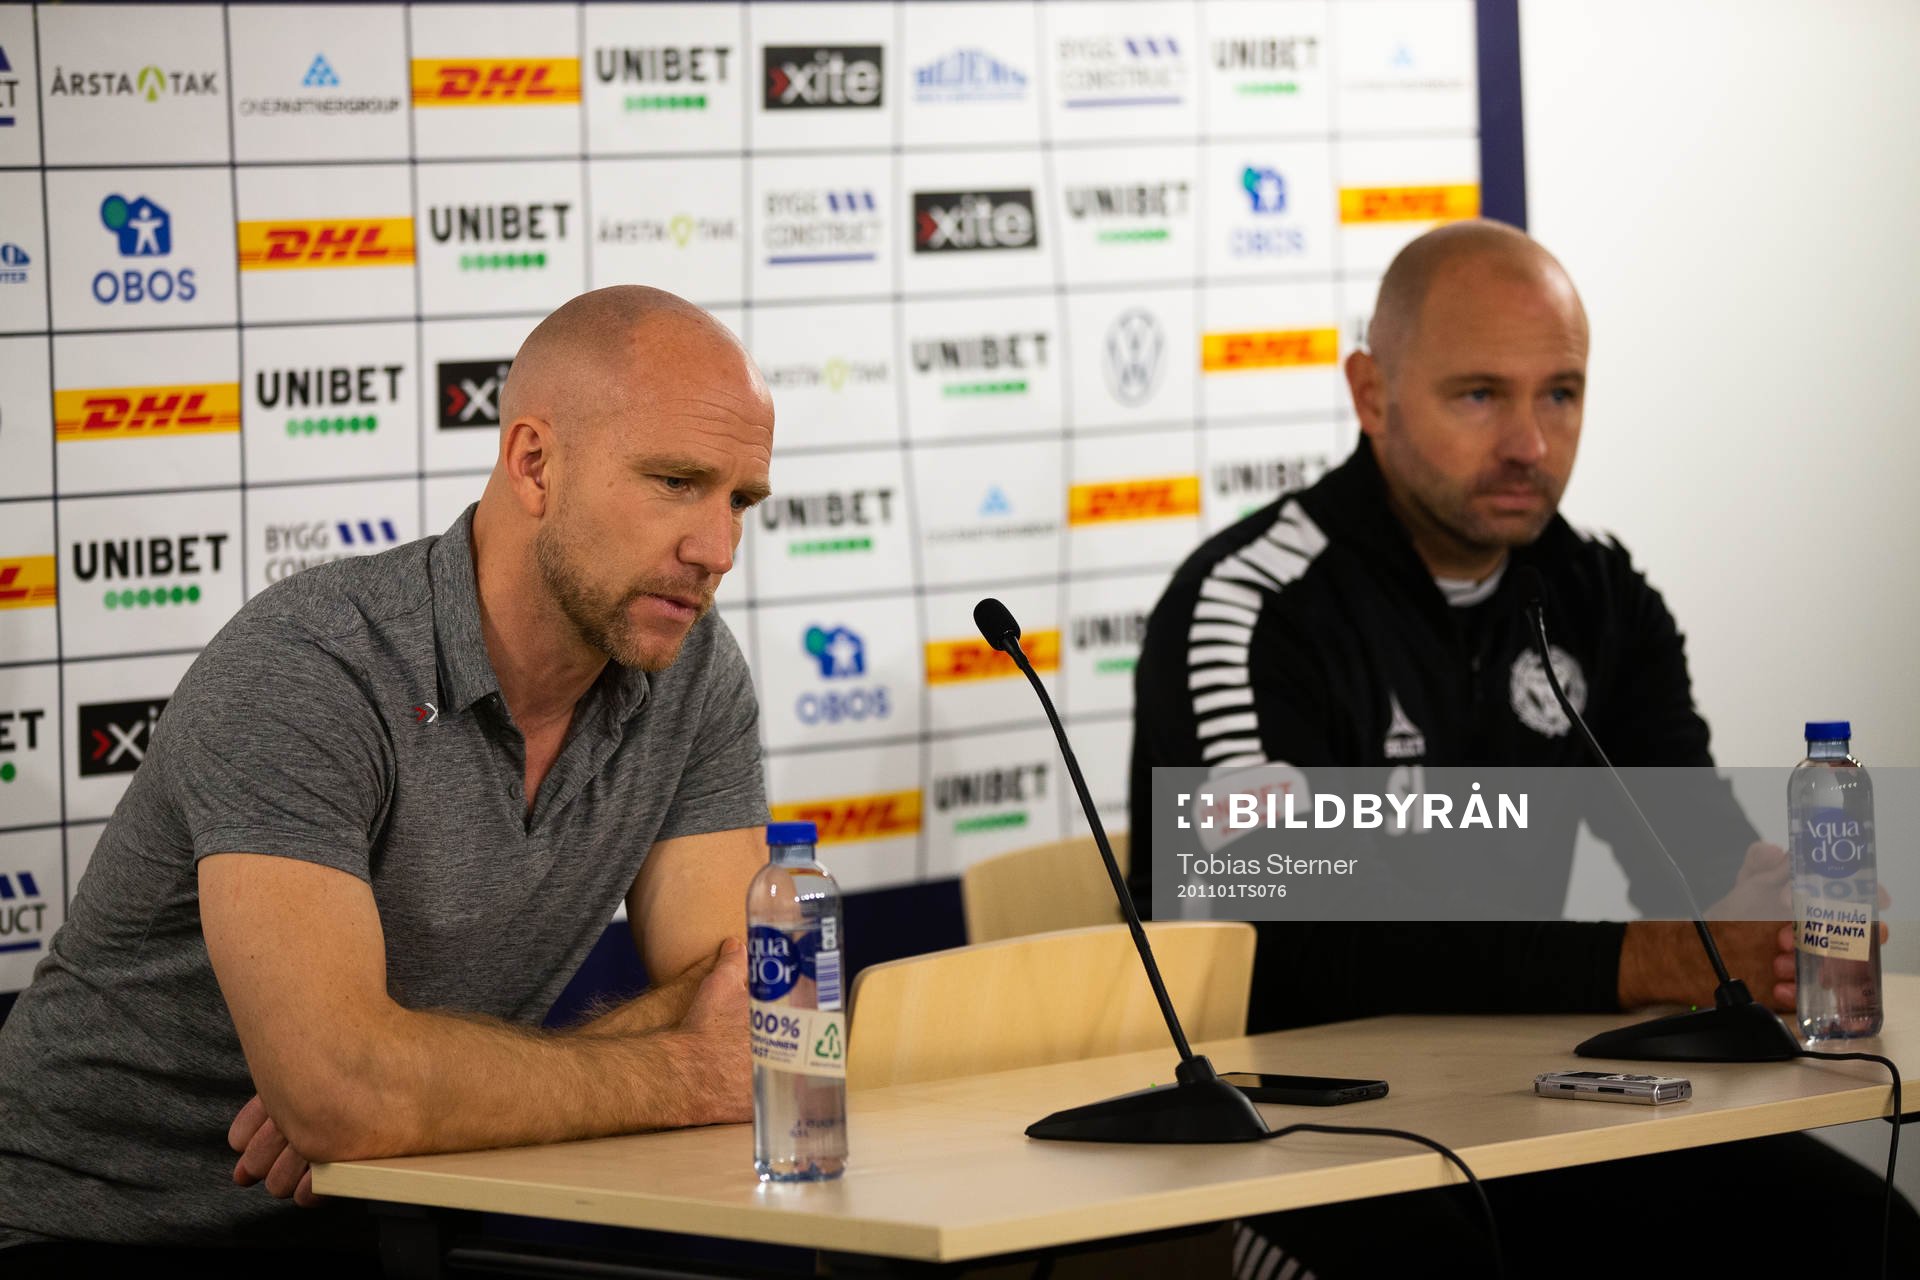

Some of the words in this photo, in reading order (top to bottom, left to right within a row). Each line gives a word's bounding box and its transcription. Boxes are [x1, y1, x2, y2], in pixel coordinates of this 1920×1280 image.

[595, 48, 730, 82] UNIBET
[1212, 37, 1319, 70] UNIBET
[51, 67, 133, 96] ÅRSTA
[172, 72, 218, 95] TAK
[437, 66, 556, 98] DHL
[783, 50, 881, 105] xite
[1065, 180, 1189, 220] UNIBET
[430, 203, 571, 243] UNIBET
[929, 194, 1034, 249] xite
[265, 226, 390, 262] DHL
[92, 268, 197, 304] OBOS
[911, 332, 1050, 372] UNIBET
[256, 366, 403, 408] UNIBET
[82, 393, 214, 431] DHL
[760, 489, 894, 530] UNIBET
[265, 521, 329, 552] BYGG
[72, 533, 228, 582] UNIBET
[796, 686, 891, 726] OBOS
[935, 766, 1049, 809] UNIBET
[1807, 820, 1860, 845] Aqua
[1805, 920, 1823, 932] ATT
[1826, 923, 1865, 938] PANTA
[1806, 906, 1834, 920] KOM
[1838, 909, 1867, 924] IHÅG
[1804, 933, 1829, 948] MIG
[752, 1010, 800, 1039] 00%
